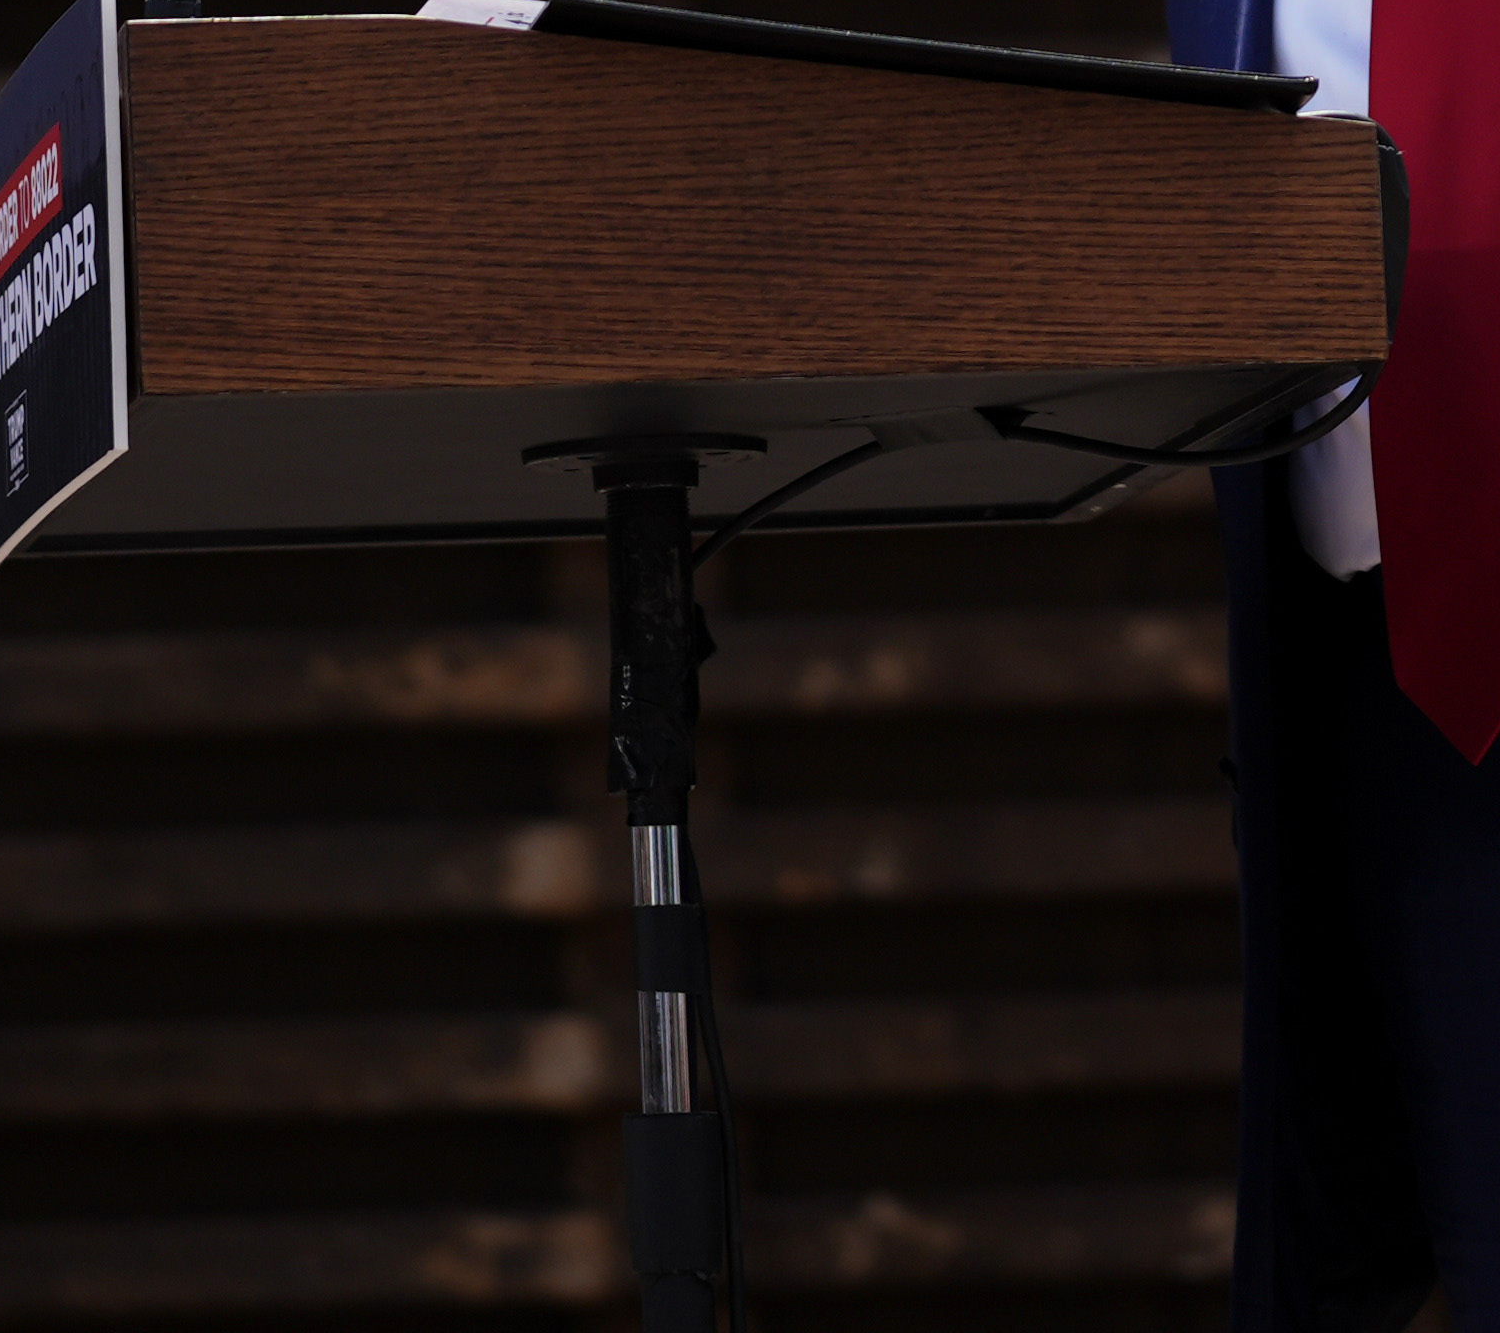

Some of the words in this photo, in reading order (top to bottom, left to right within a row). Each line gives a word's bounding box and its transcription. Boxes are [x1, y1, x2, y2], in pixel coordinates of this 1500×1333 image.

[19, 175, 30, 233] TO
[31, 143, 59, 220] 88022
[33, 203, 97, 337] BORDER
